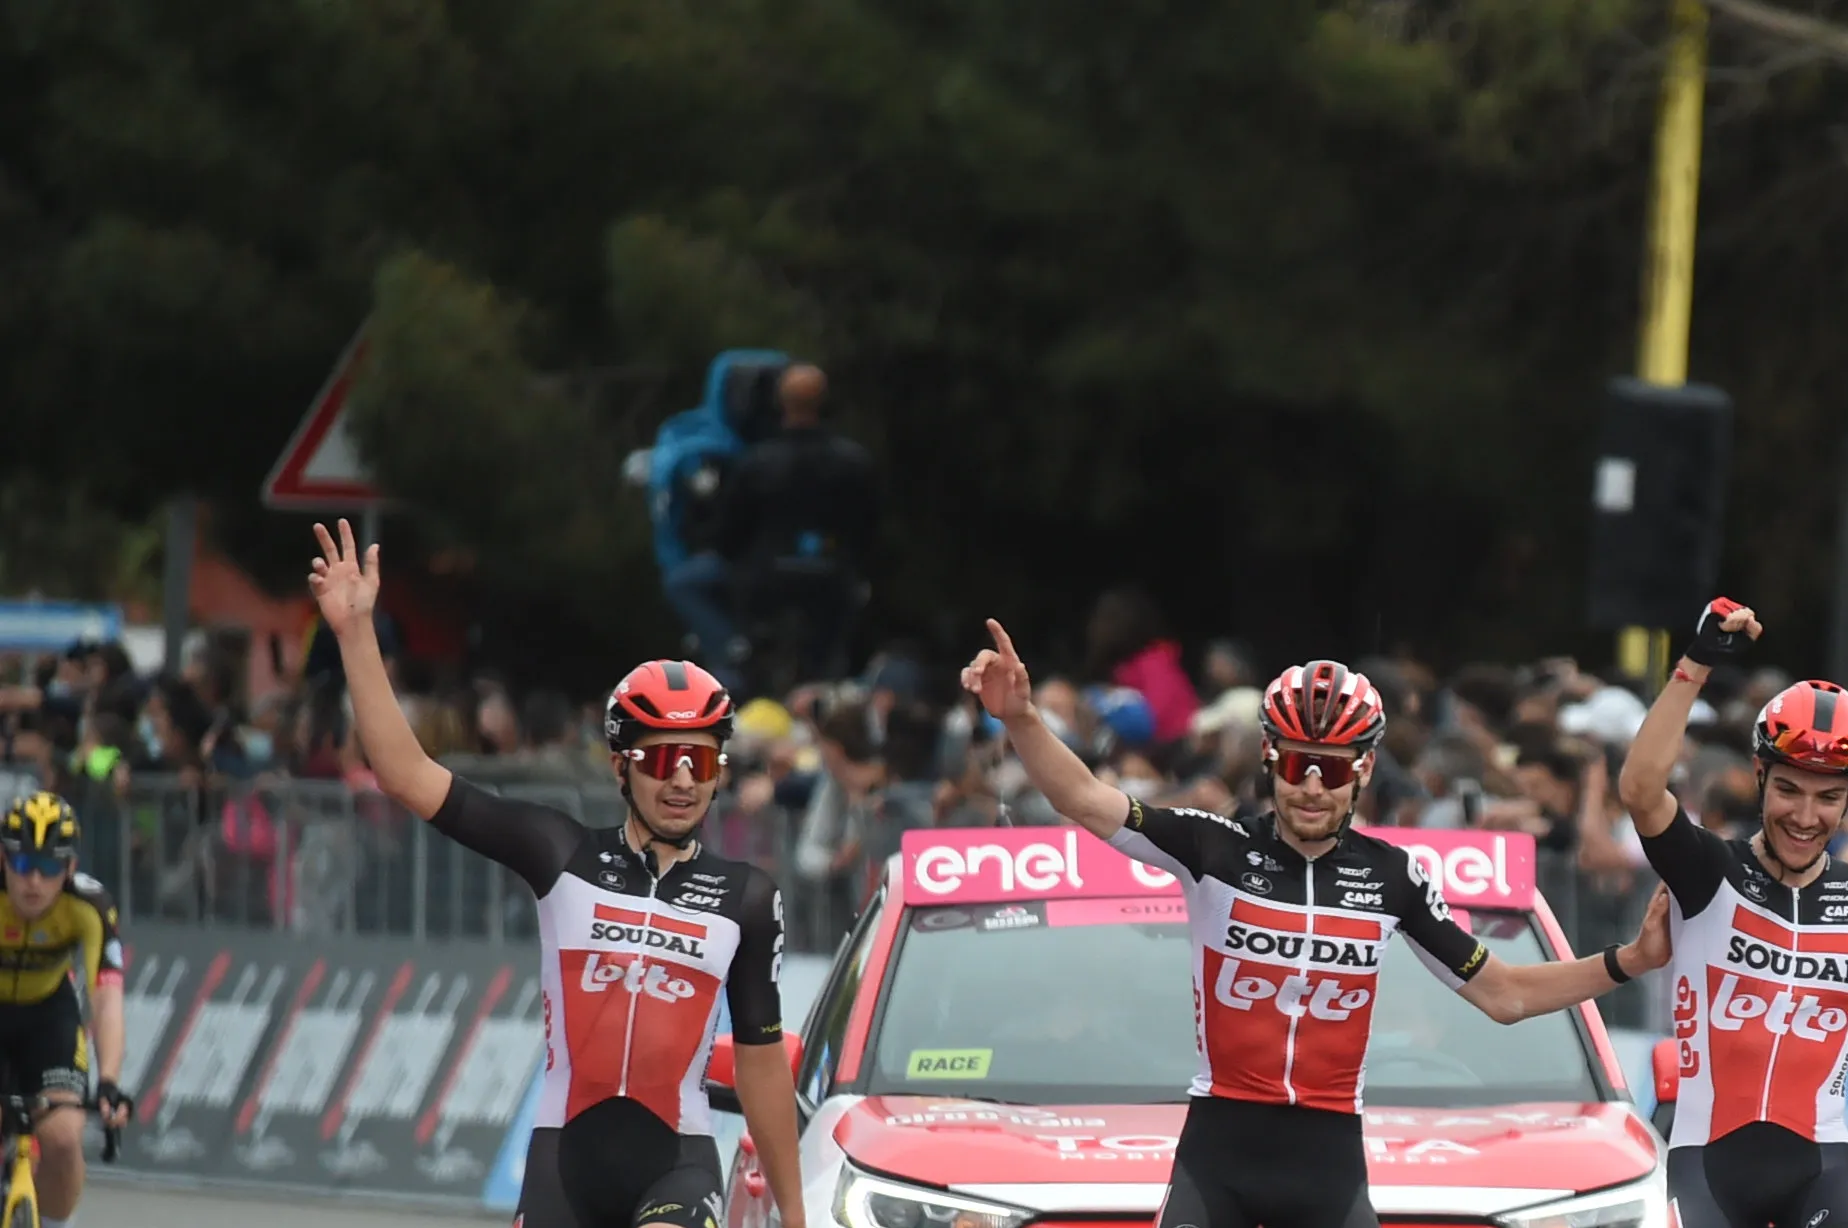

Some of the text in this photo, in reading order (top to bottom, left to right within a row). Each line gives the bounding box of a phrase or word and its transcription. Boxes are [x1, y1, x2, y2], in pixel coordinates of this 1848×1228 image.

[914, 830, 1084, 895] enel
[1399, 835, 1512, 896] nel
[681, 892, 722, 908] CAPS
[1344, 891, 1384, 906] CAPS
[590, 921, 705, 960] SOUDAL
[1224, 924, 1379, 968] SOUDAL
[917, 1056, 982, 1073] RACE
